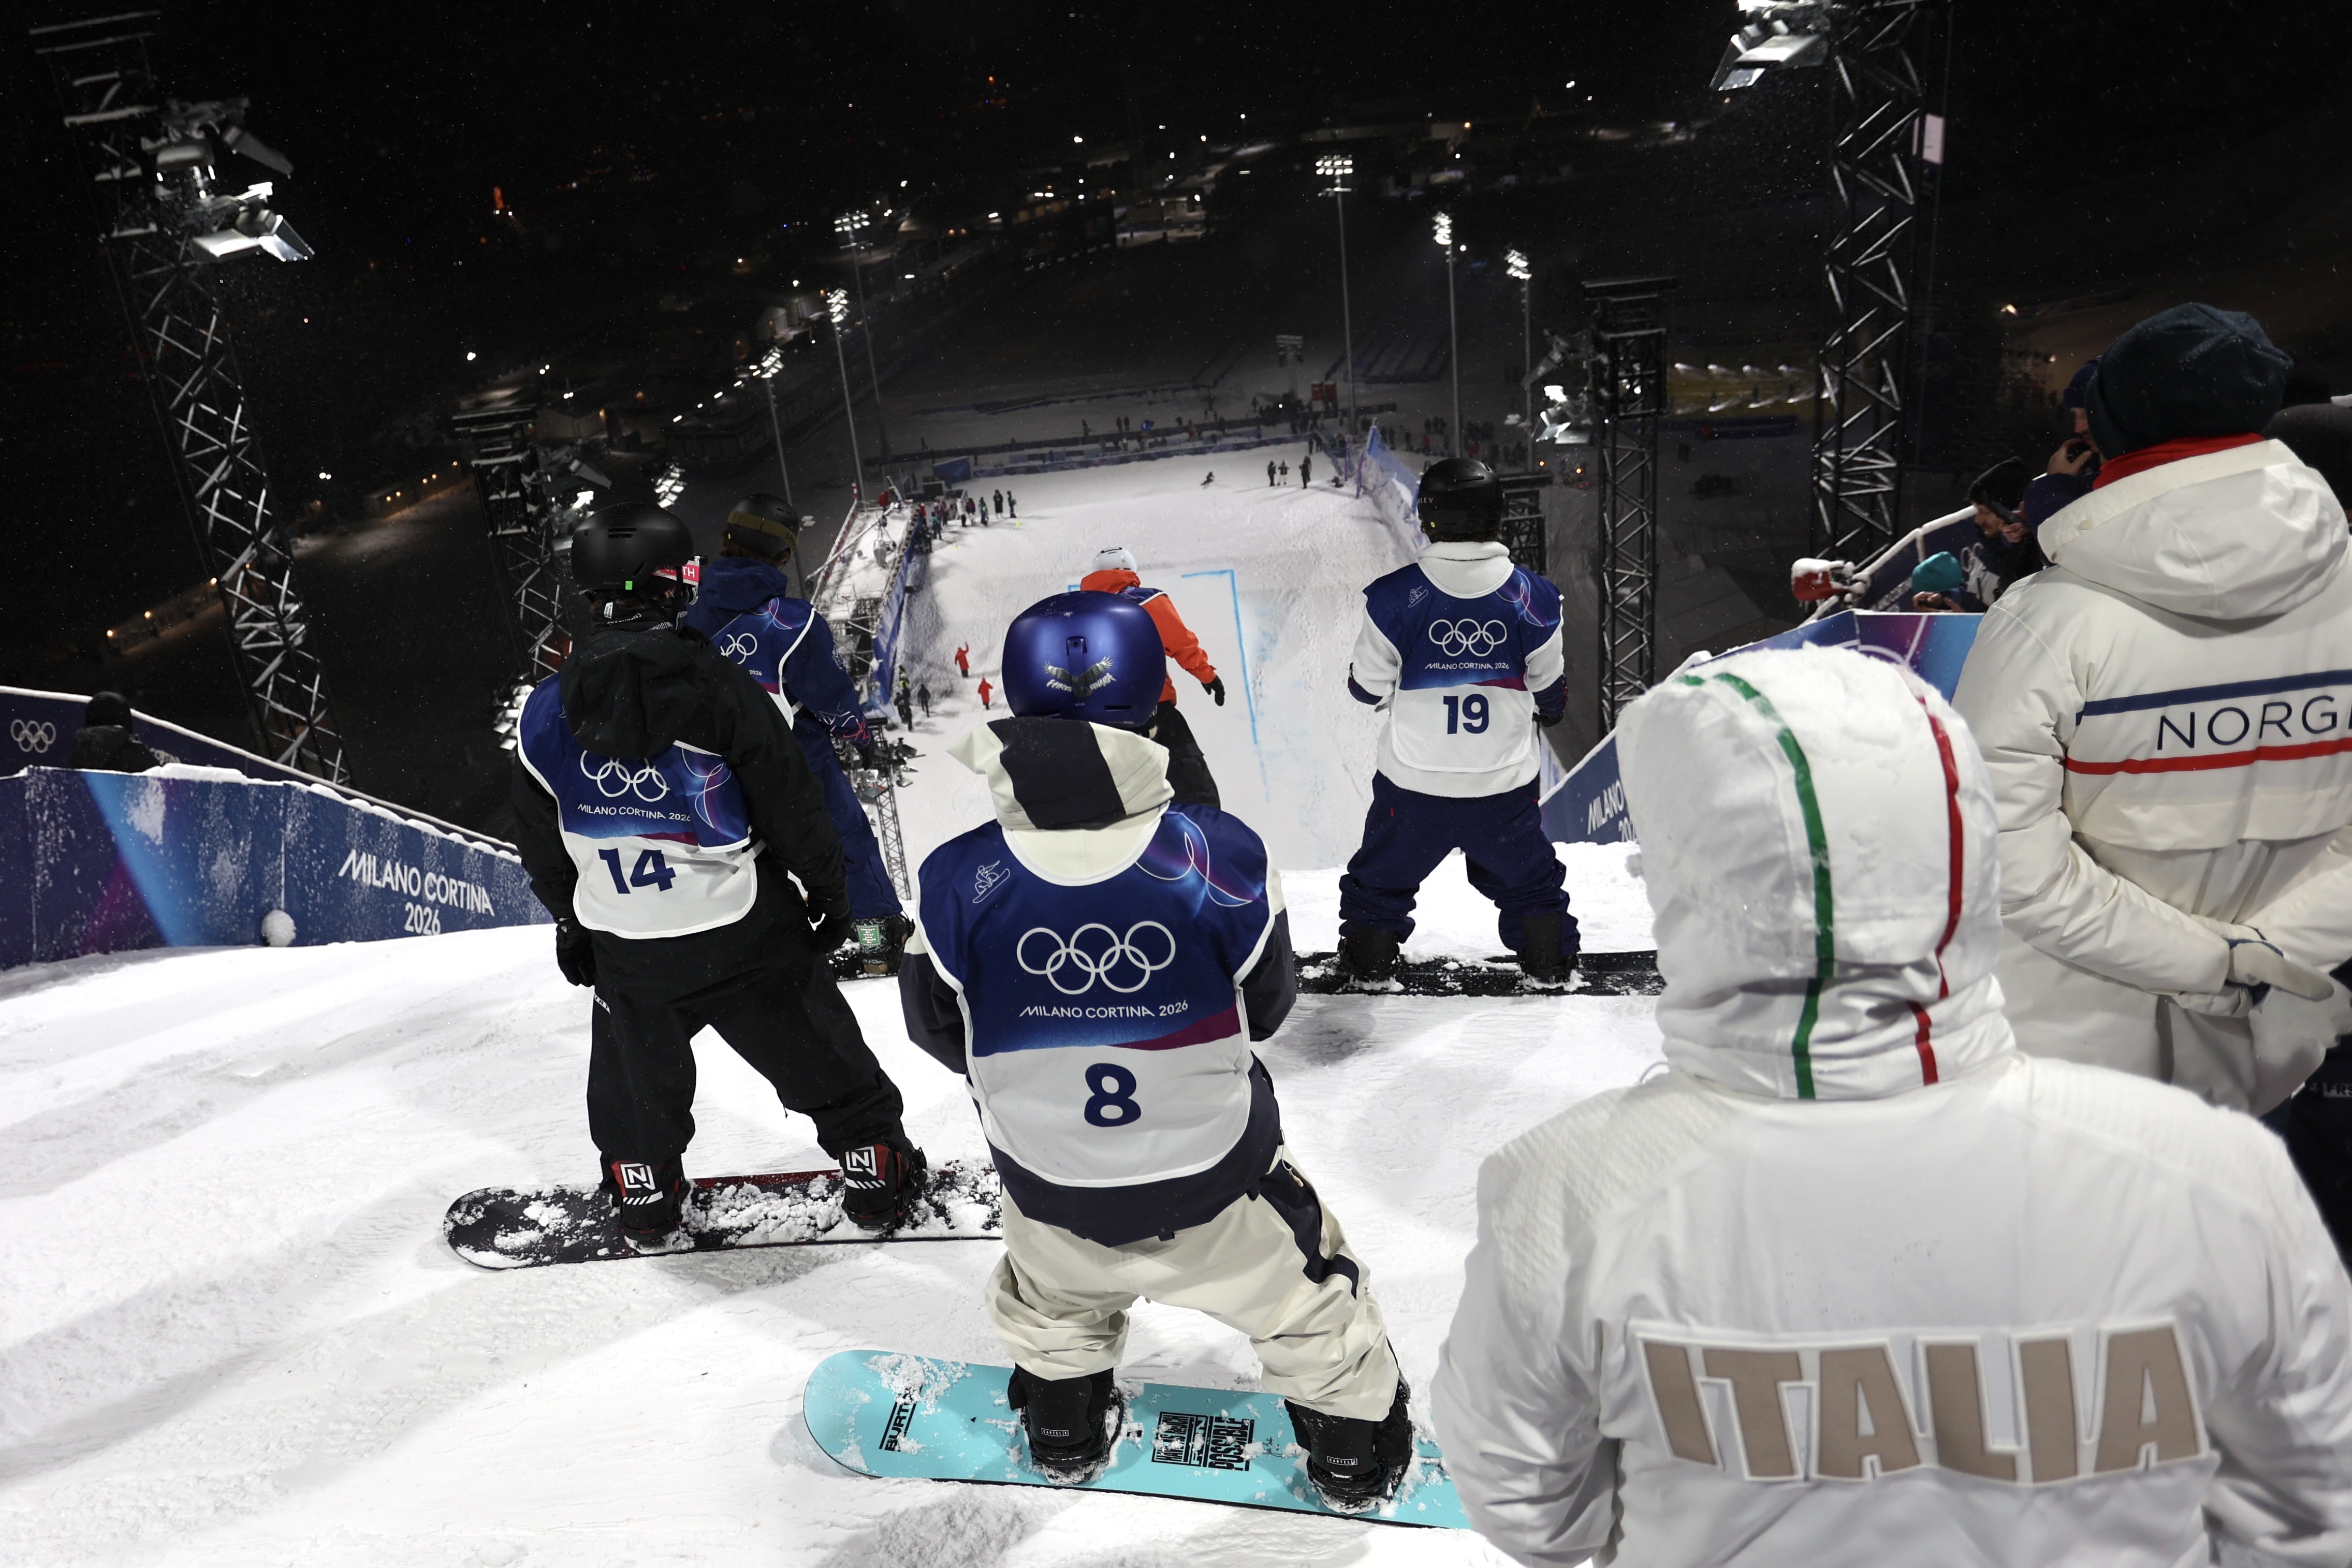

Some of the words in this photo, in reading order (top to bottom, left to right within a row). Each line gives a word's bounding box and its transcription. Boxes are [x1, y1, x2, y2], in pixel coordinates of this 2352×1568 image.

[1442, 693, 1489, 735] 19
[2157, 695, 2352, 751] NORG
[577, 803, 617, 816] MILANO
[619, 806, 667, 820] CORTINA
[669, 812, 691, 822] 2026
[1587, 778, 1625, 836] MILANO
[338, 849, 421, 897] MILANO
[424, 871, 495, 917] CORTINA
[597, 847, 677, 895] 14
[404, 902, 441, 936] 2026
[1019, 1006, 1083, 1019] MILANO
[1085, 1005, 1156, 1019] CORTINA
[1159, 1000, 1189, 1017] 2026
[1084, 1062, 1142, 1127] 8
[1636, 1323, 2205, 1485] ITALIA
[1192, 1417, 1207, 1465] FN
[1208, 1416, 1250, 1471] POSSIBLE
